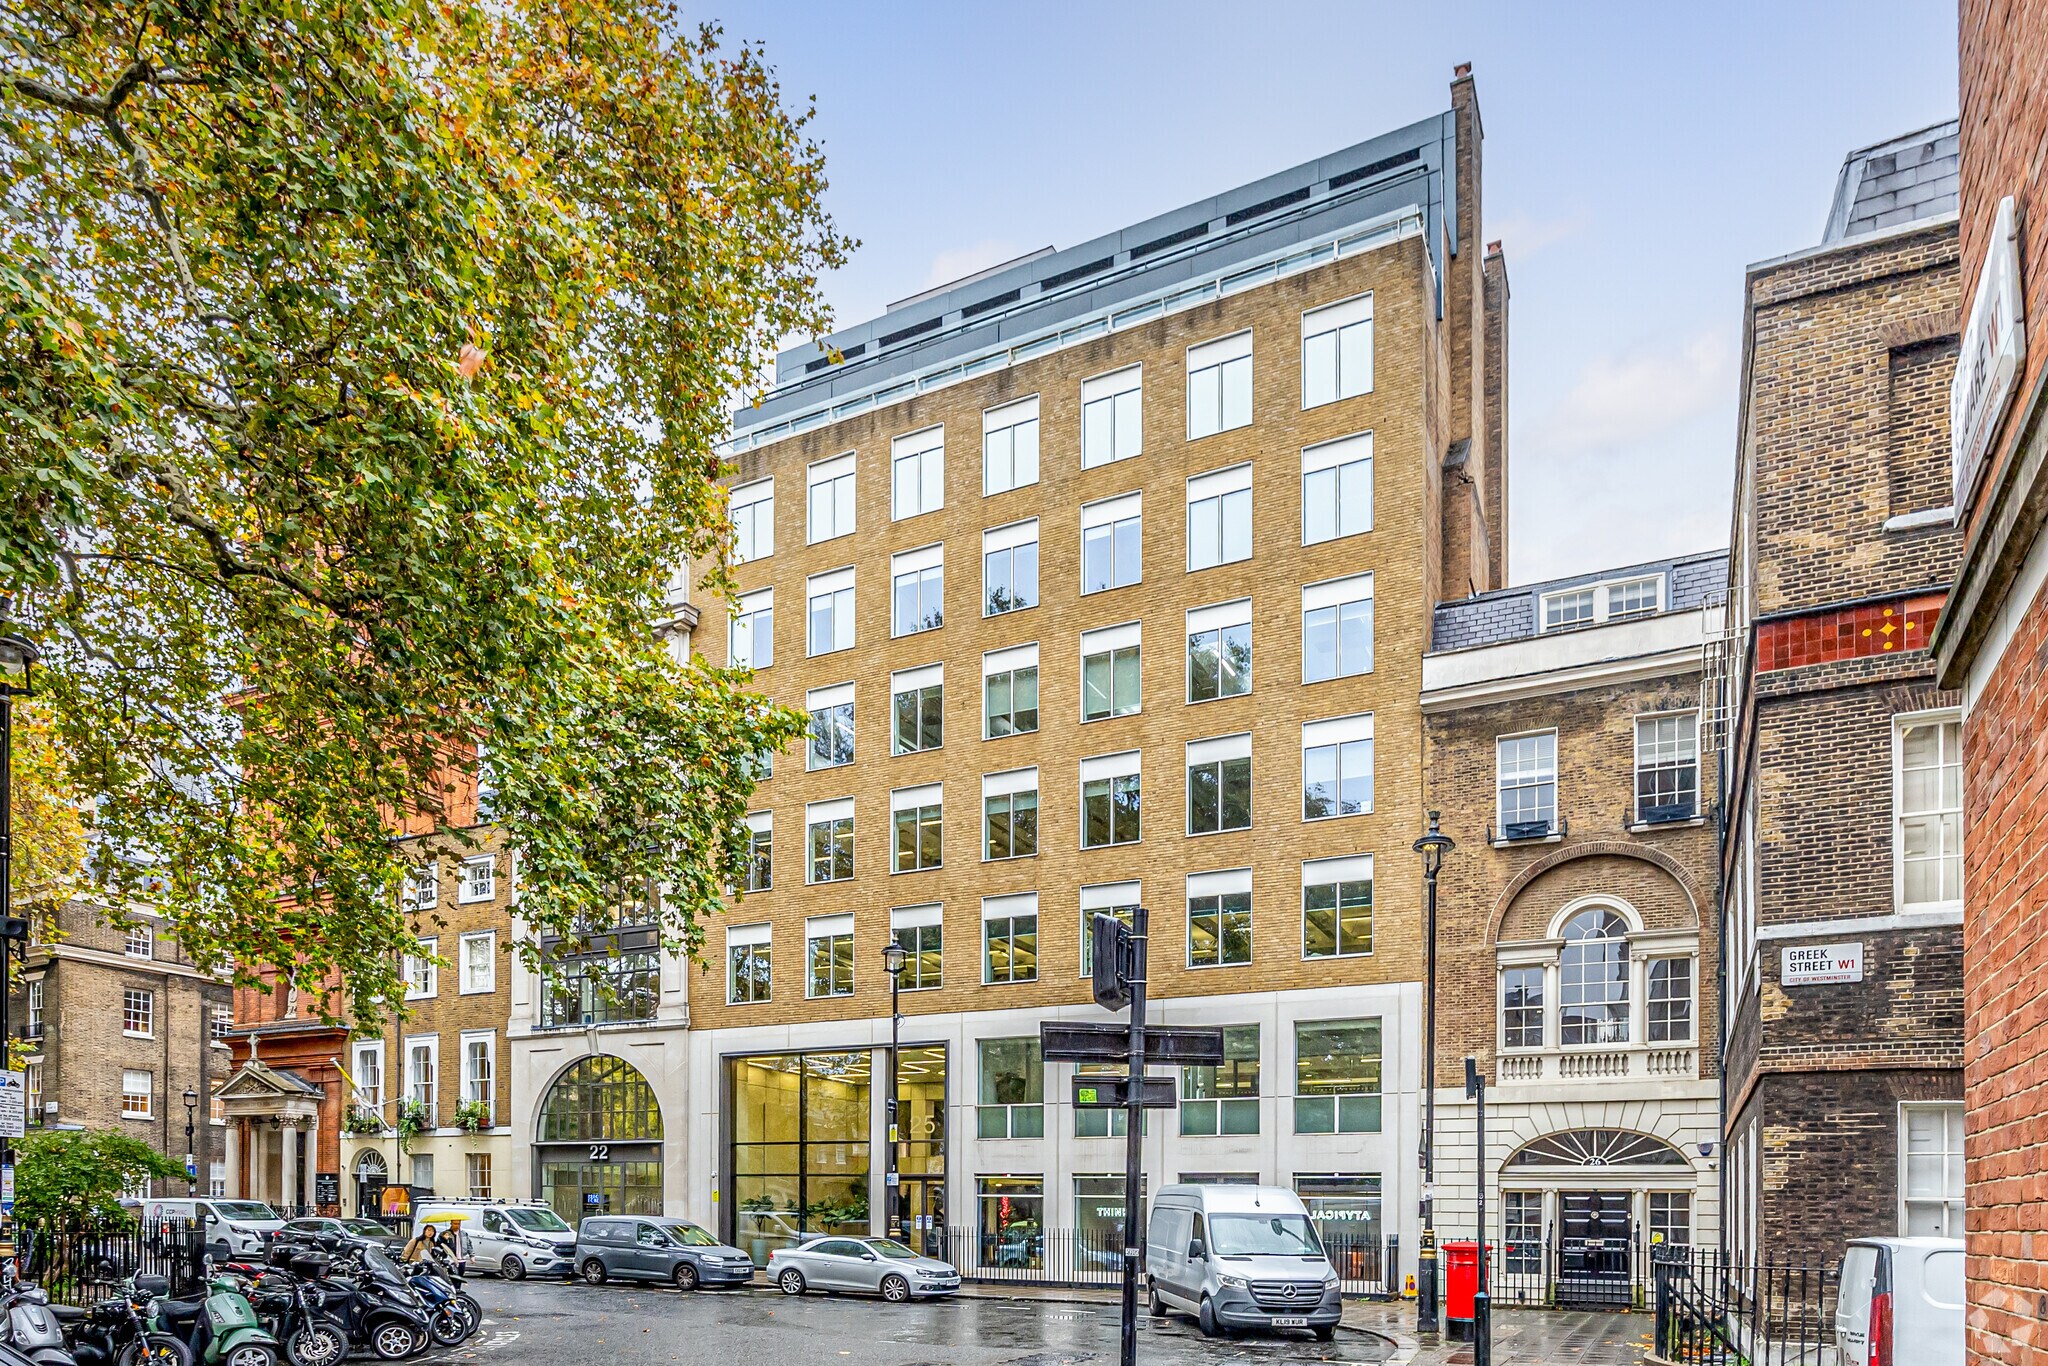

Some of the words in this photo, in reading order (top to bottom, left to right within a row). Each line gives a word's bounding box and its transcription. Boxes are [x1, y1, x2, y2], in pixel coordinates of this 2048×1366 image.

[1789, 949, 1828, 961] GREEK
[1789, 960, 1833, 972] STREET
[1837, 959, 1855, 970] W1
[910, 1115, 936, 1134] 25
[590, 1145, 608, 1159] 22
[1589, 1158, 1601, 1166] 26
